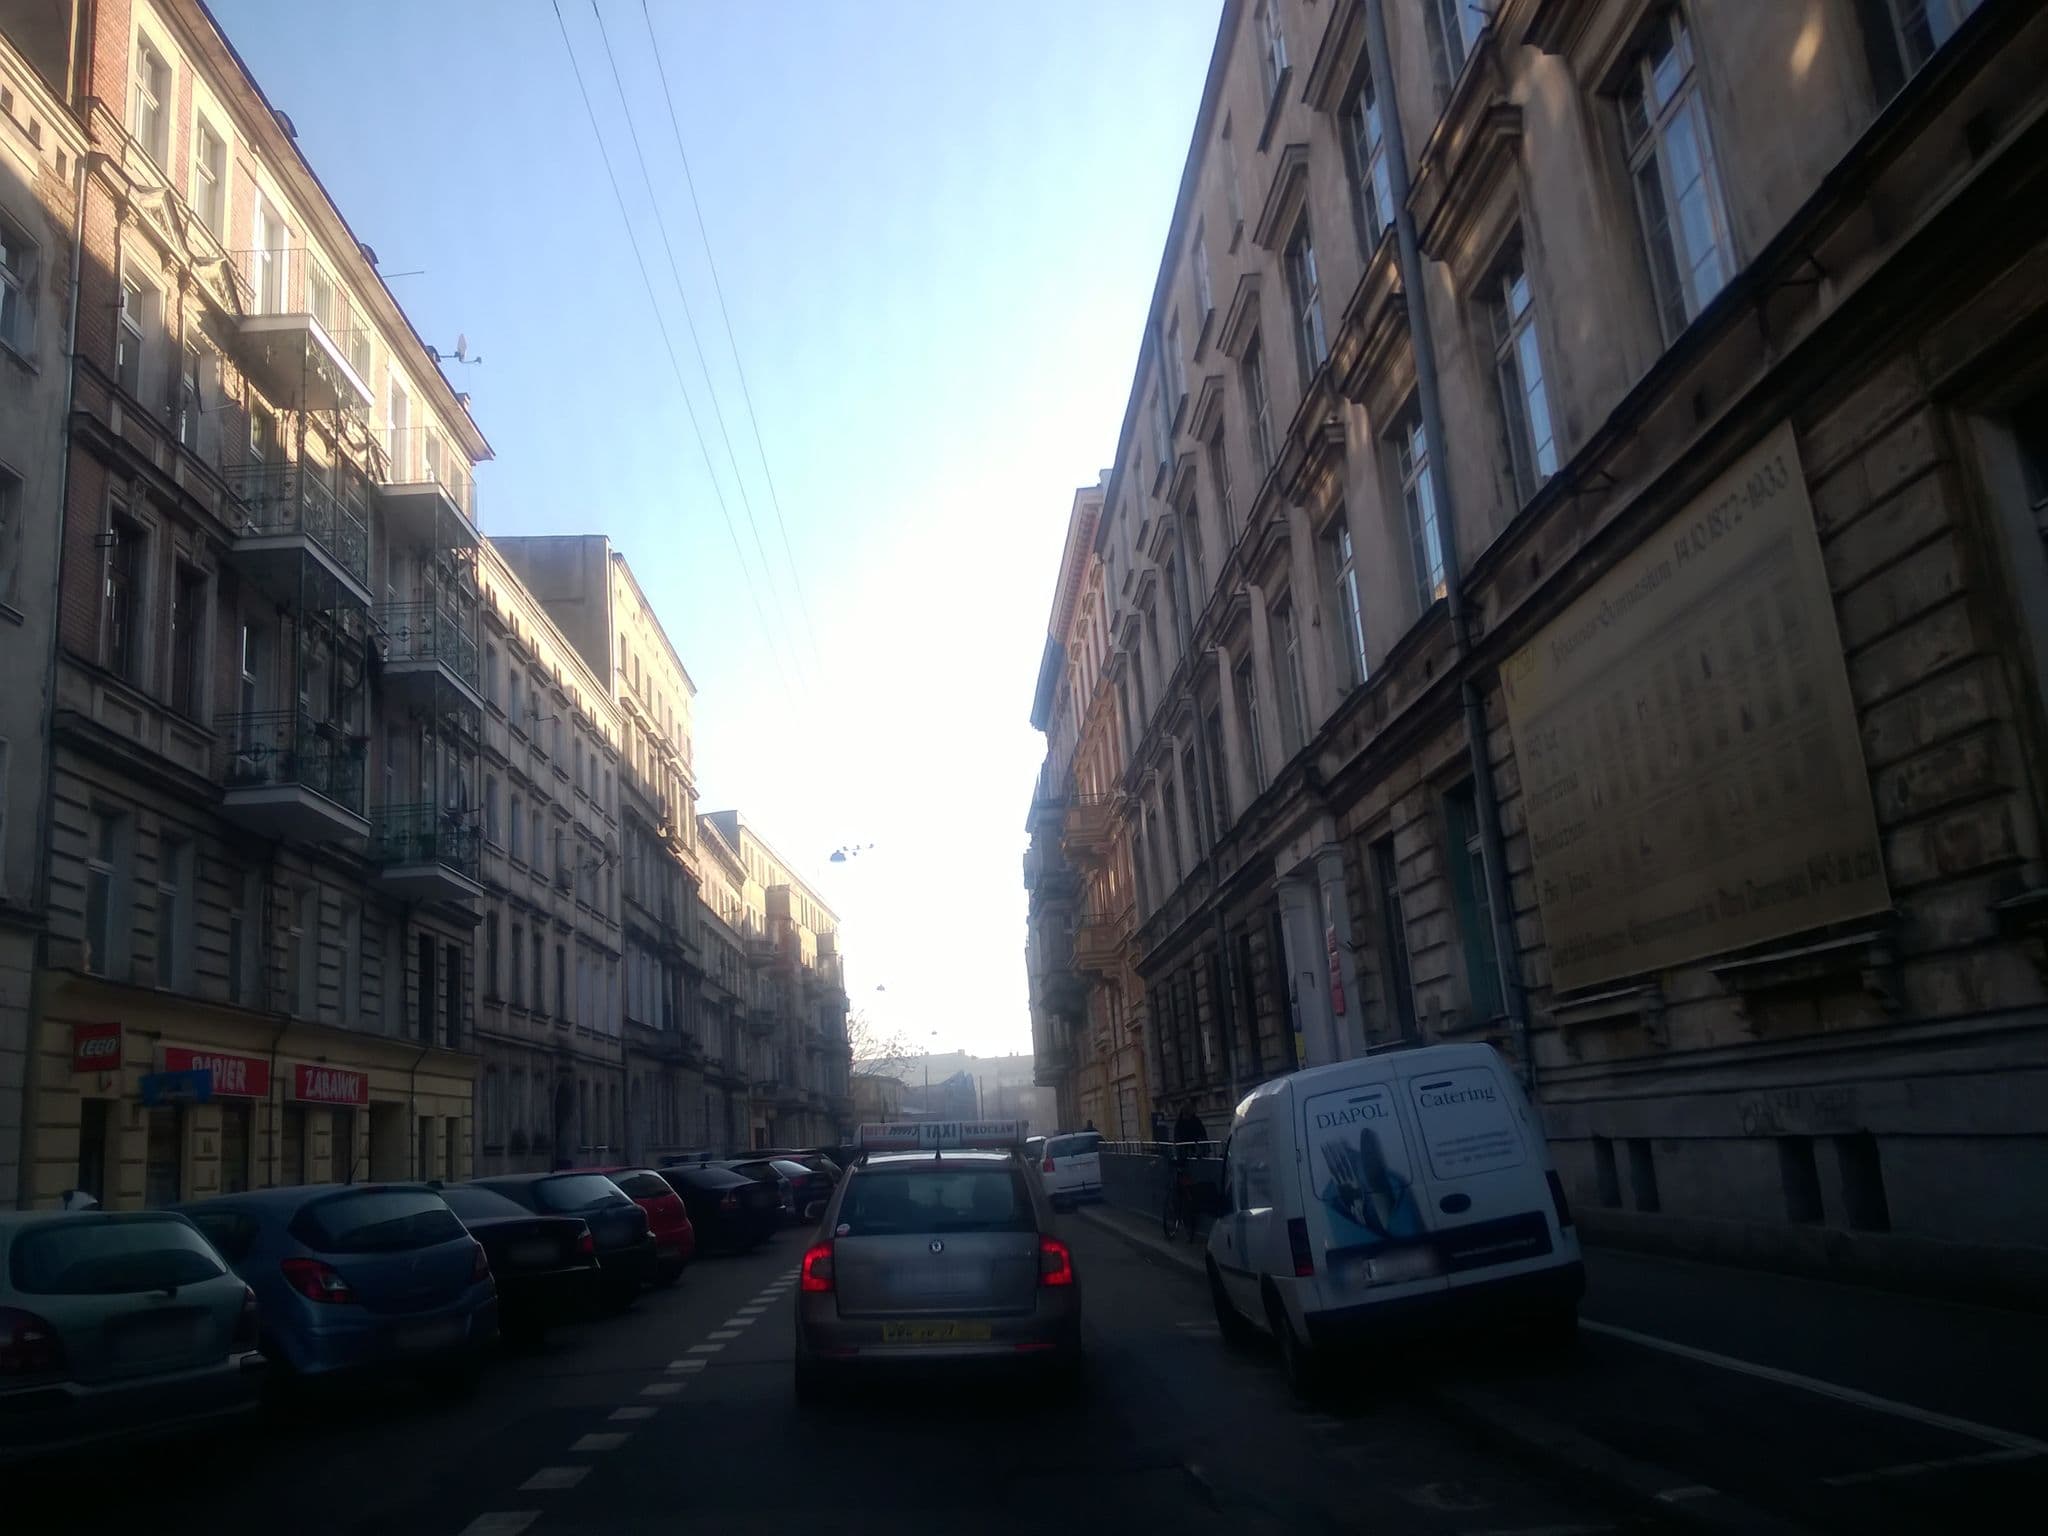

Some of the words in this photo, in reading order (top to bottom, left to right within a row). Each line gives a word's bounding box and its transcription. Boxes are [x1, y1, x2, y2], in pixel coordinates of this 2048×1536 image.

[79, 1037, 118, 1057] LEGO
[304, 1069, 360, 1100] ZABAWKI
[1420, 1086, 1497, 1109] Catering
[1315, 1103, 1390, 1130] DIAPOL
[926, 1123, 957, 1139] TAXI
